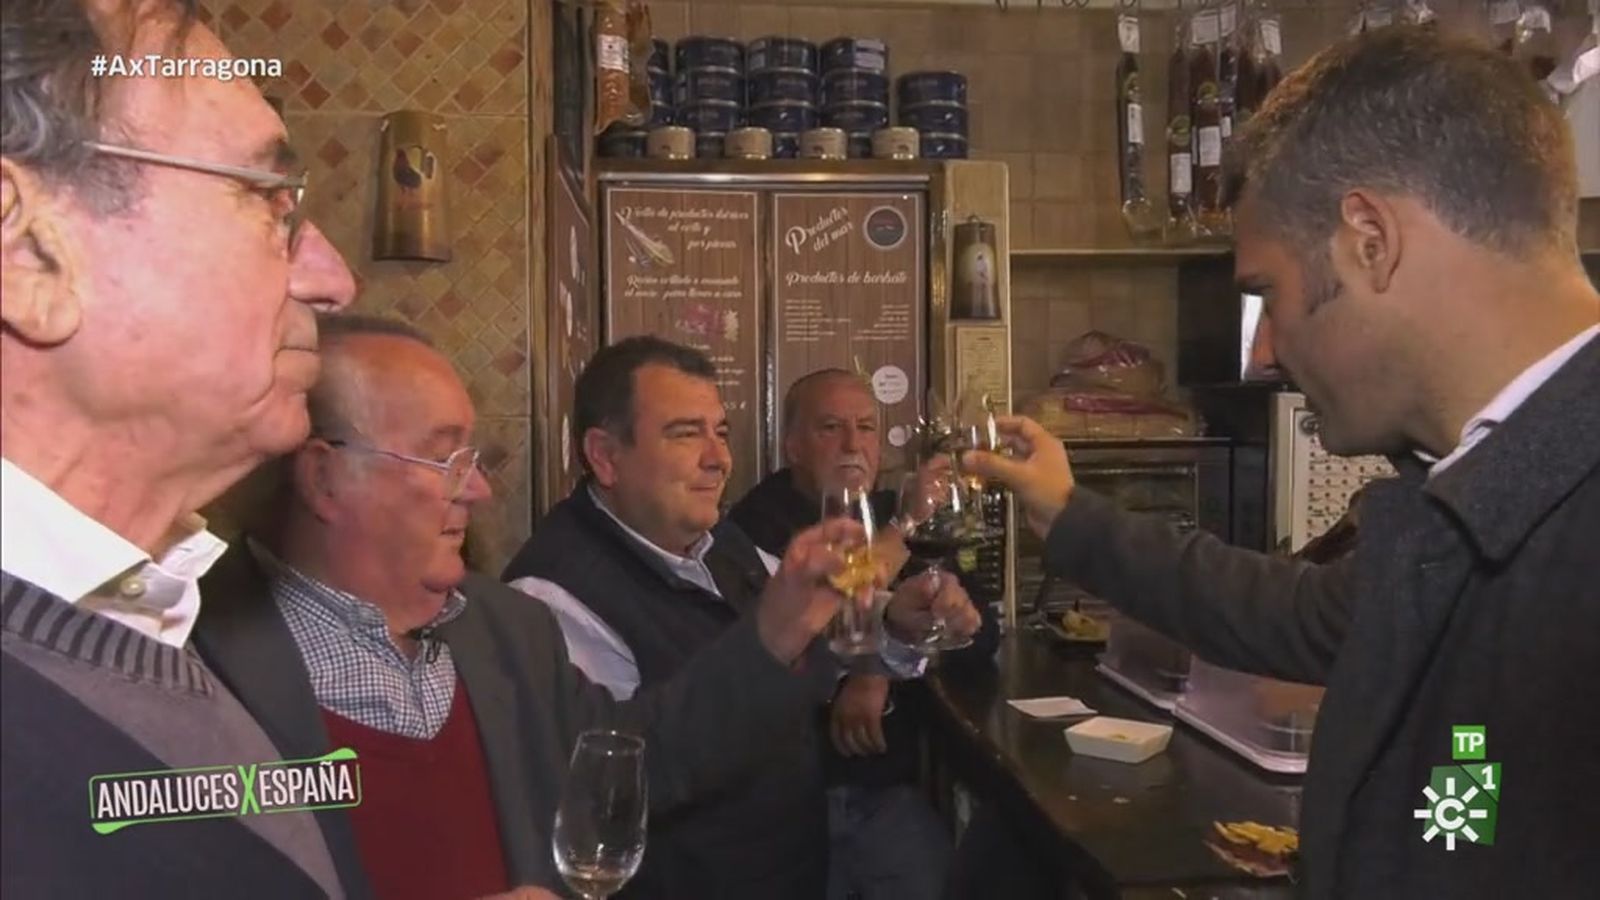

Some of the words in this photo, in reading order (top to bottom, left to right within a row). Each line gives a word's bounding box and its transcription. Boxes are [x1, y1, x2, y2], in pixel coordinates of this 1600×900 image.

[785, 207, 848, 254] Productos
[813, 232, 830, 252] del
[831, 222, 853, 240] mar
[786, 271, 844, 287] Productos
[847, 271, 861, 283] de
